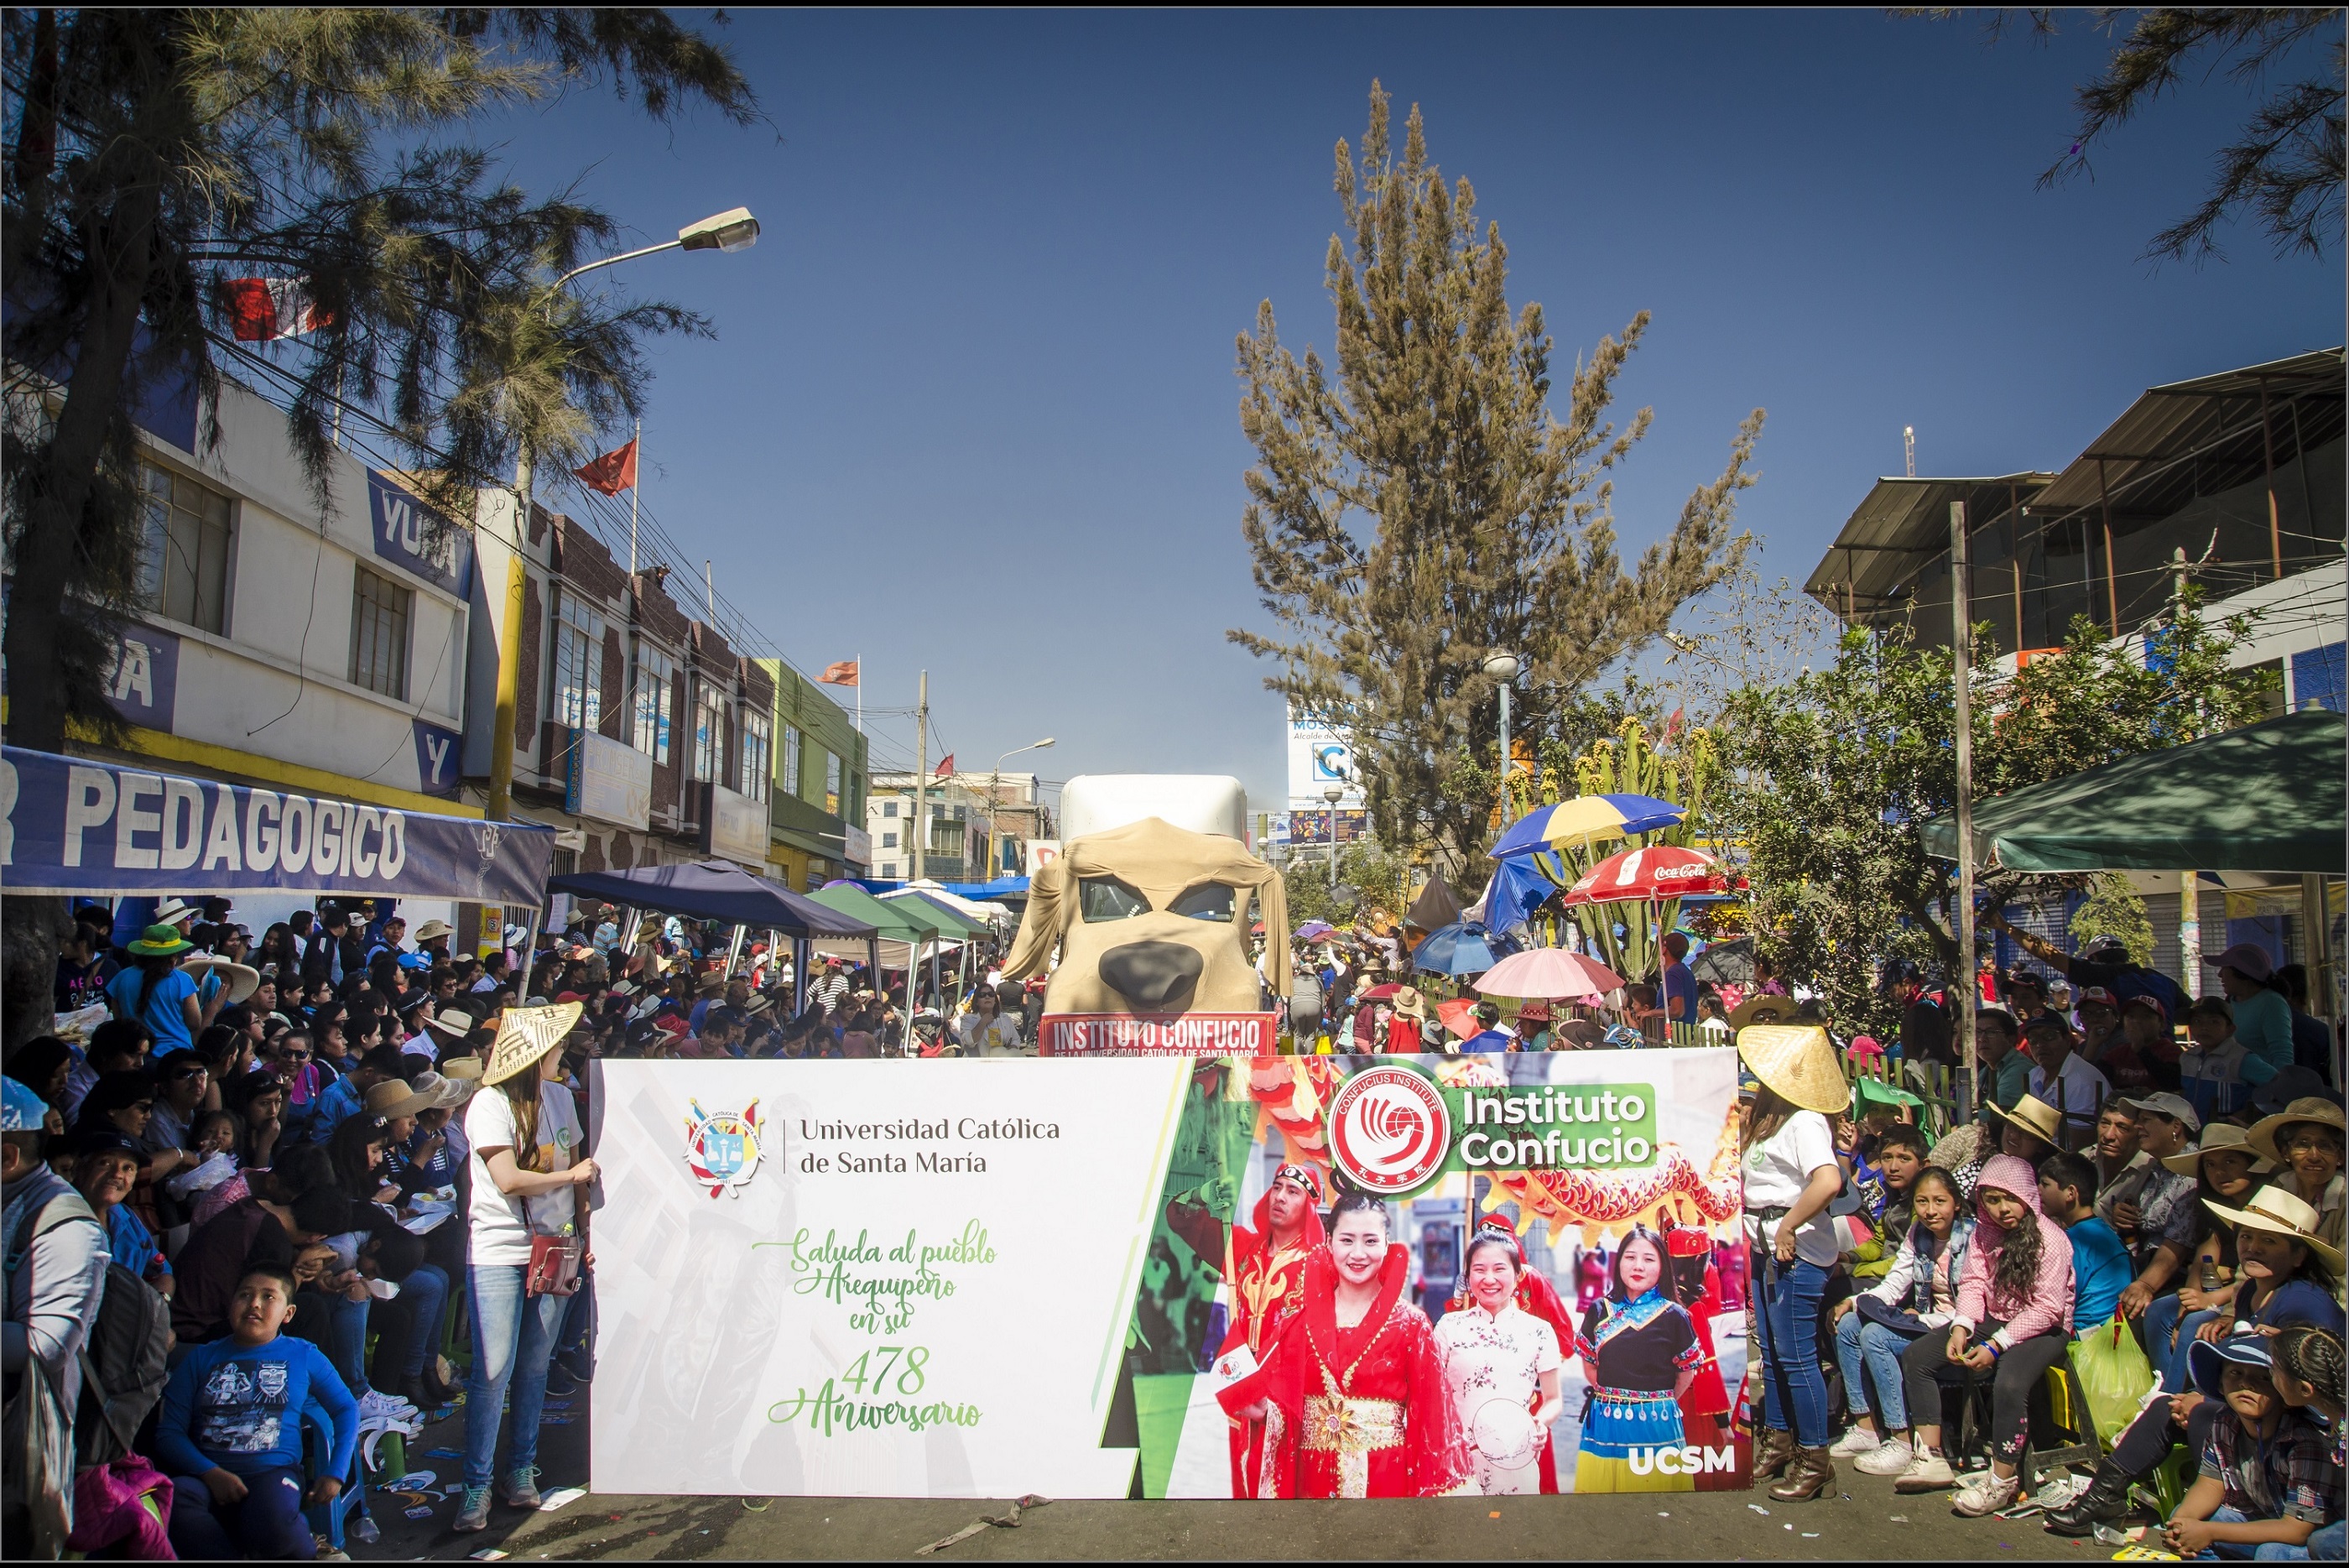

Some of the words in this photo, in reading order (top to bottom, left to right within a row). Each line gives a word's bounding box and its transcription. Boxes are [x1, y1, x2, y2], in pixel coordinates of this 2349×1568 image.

[63, 765, 406, 880] PEDAGOGICO
[70, 976, 103, 988] AEO
[1054, 1019, 1156, 1050] INSTITUTO
[1161, 1019, 1260, 1049] CONFUCIO
[1081, 1049, 1139, 1057] UNIVERSIDAD
[1339, 1074, 1391, 1115] CONFUCIUS
[1393, 1074, 1440, 1114] INSTITUTE
[1463, 1086, 1646, 1125] Instituto
[691, 1120, 711, 1148] UNIVERSIDAD
[800, 1117, 949, 1140] Universidad
[957, 1116, 1060, 1140] Católica
[1460, 1127, 1650, 1167] Confucio
[800, 1152, 830, 1174] de
[837, 1152, 908, 1174] Santa
[916, 1151, 987, 1174] María
[1357, 1163, 1427, 1185] 孔子学院
[752, 1227, 883, 1271] Saluda
[888, 1228, 916, 1263] al
[920, 1218, 997, 1279] pueblo
[849, 1311, 882, 1335] en
[885, 1310, 911, 1335] su
[841, 1346, 930, 1395] 478
[768, 1378, 982, 1438] Aniversario
[1628, 1446, 1735, 1476] UCSM
